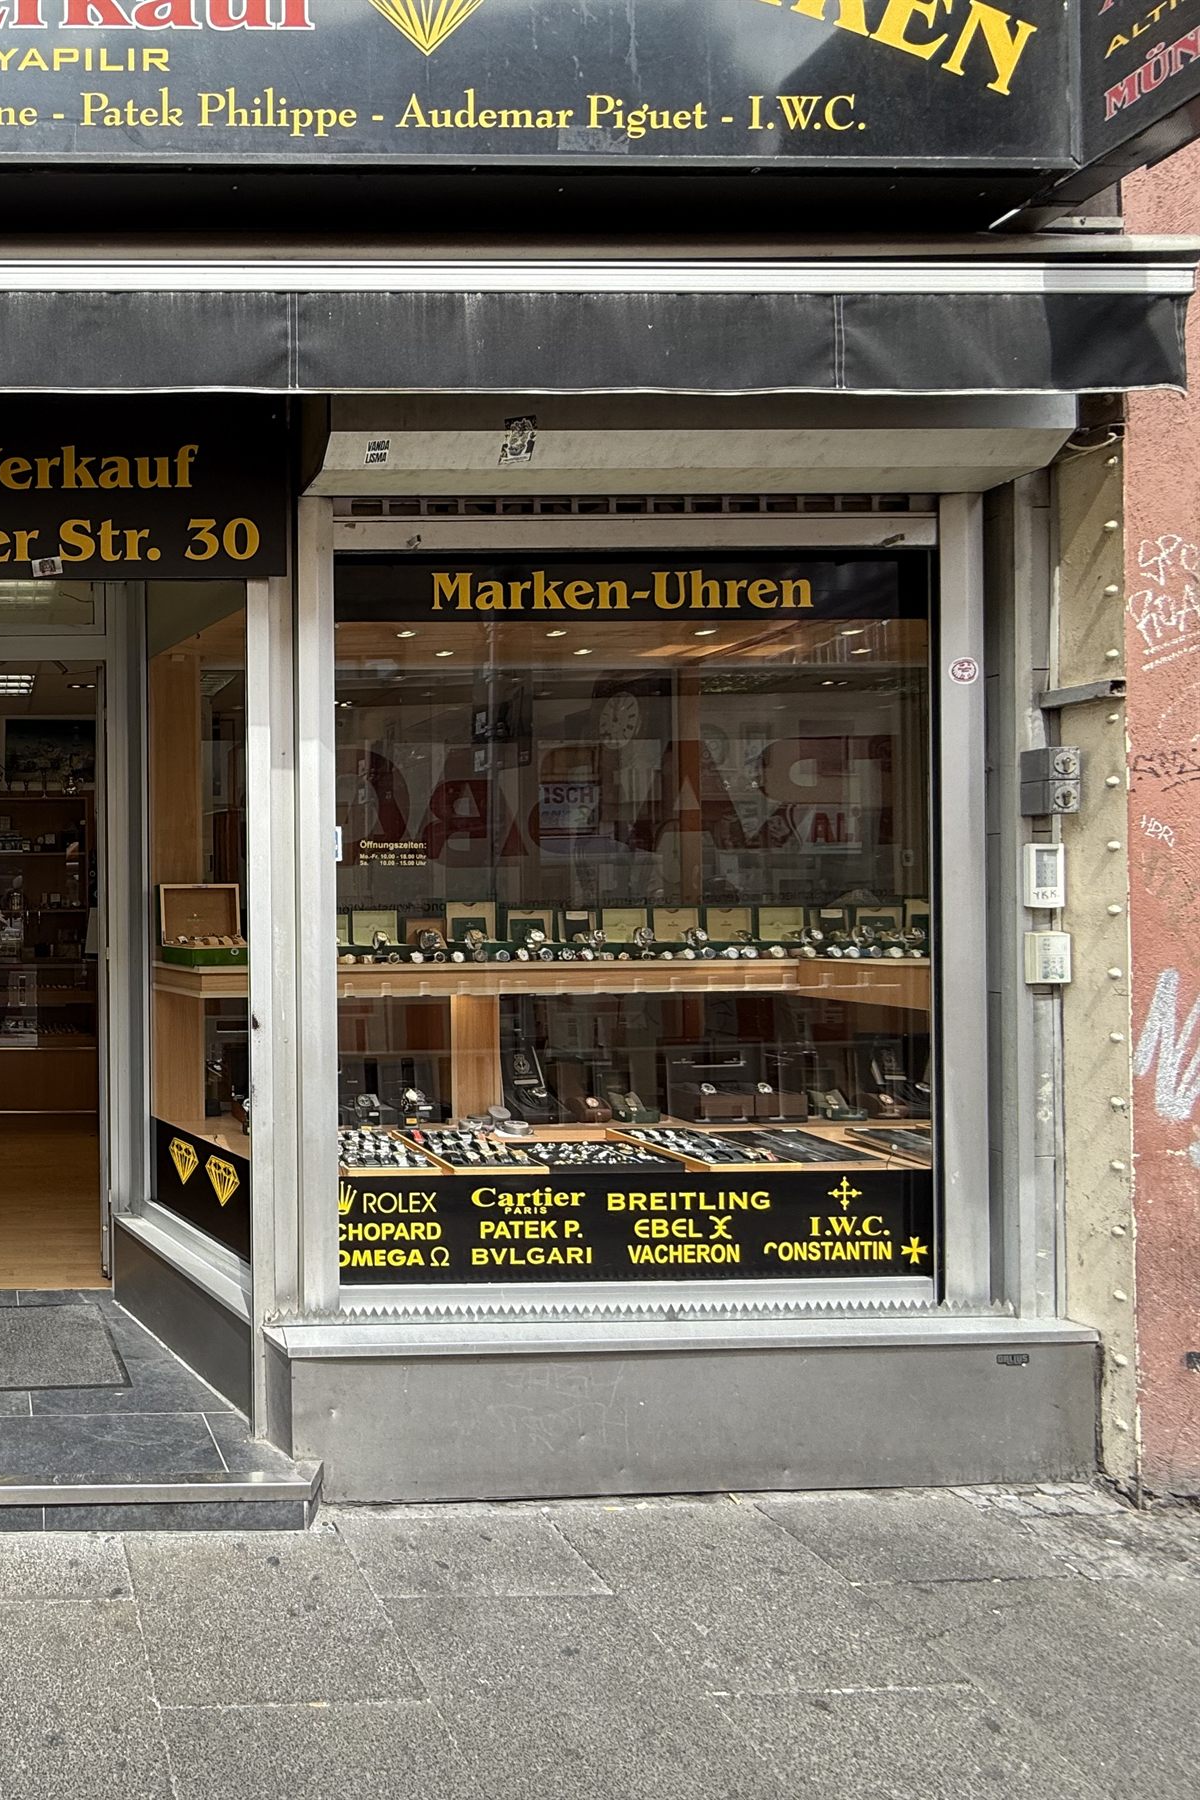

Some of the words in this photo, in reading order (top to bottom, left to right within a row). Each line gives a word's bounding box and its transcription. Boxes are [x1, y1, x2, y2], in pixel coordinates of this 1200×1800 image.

[80, 87, 185, 127] Patek
[197, 87, 359, 137] Philippe
[397, 88, 575, 130] Audemar
[587, 94, 708, 140] Piguet
[747, 94, 867, 130] I.W.C.
[58, 518, 161, 562] Str.
[184, 517, 260, 561] 30
[431, 569, 814, 611] Marken-Uhren
[359, 840, 428, 851] Öffnungszeiten:
[363, 1192, 437, 1214] ROLEX
[471, 1187, 586, 1208] Cartier
[607, 1191, 770, 1211] BREITLING
[504, 1207, 547, 1215] PARIS
[480, 1220, 557, 1239] PATEK
[565, 1219, 583, 1239] P.
[634, 1218, 703, 1239] EBEL
[810, 1216, 890, 1237] I.W.C.
[339, 1249, 424, 1267] OMEGA
[472, 1247, 592, 1266] BVLGARI
[628, 1243, 740, 1264] VACHERON
